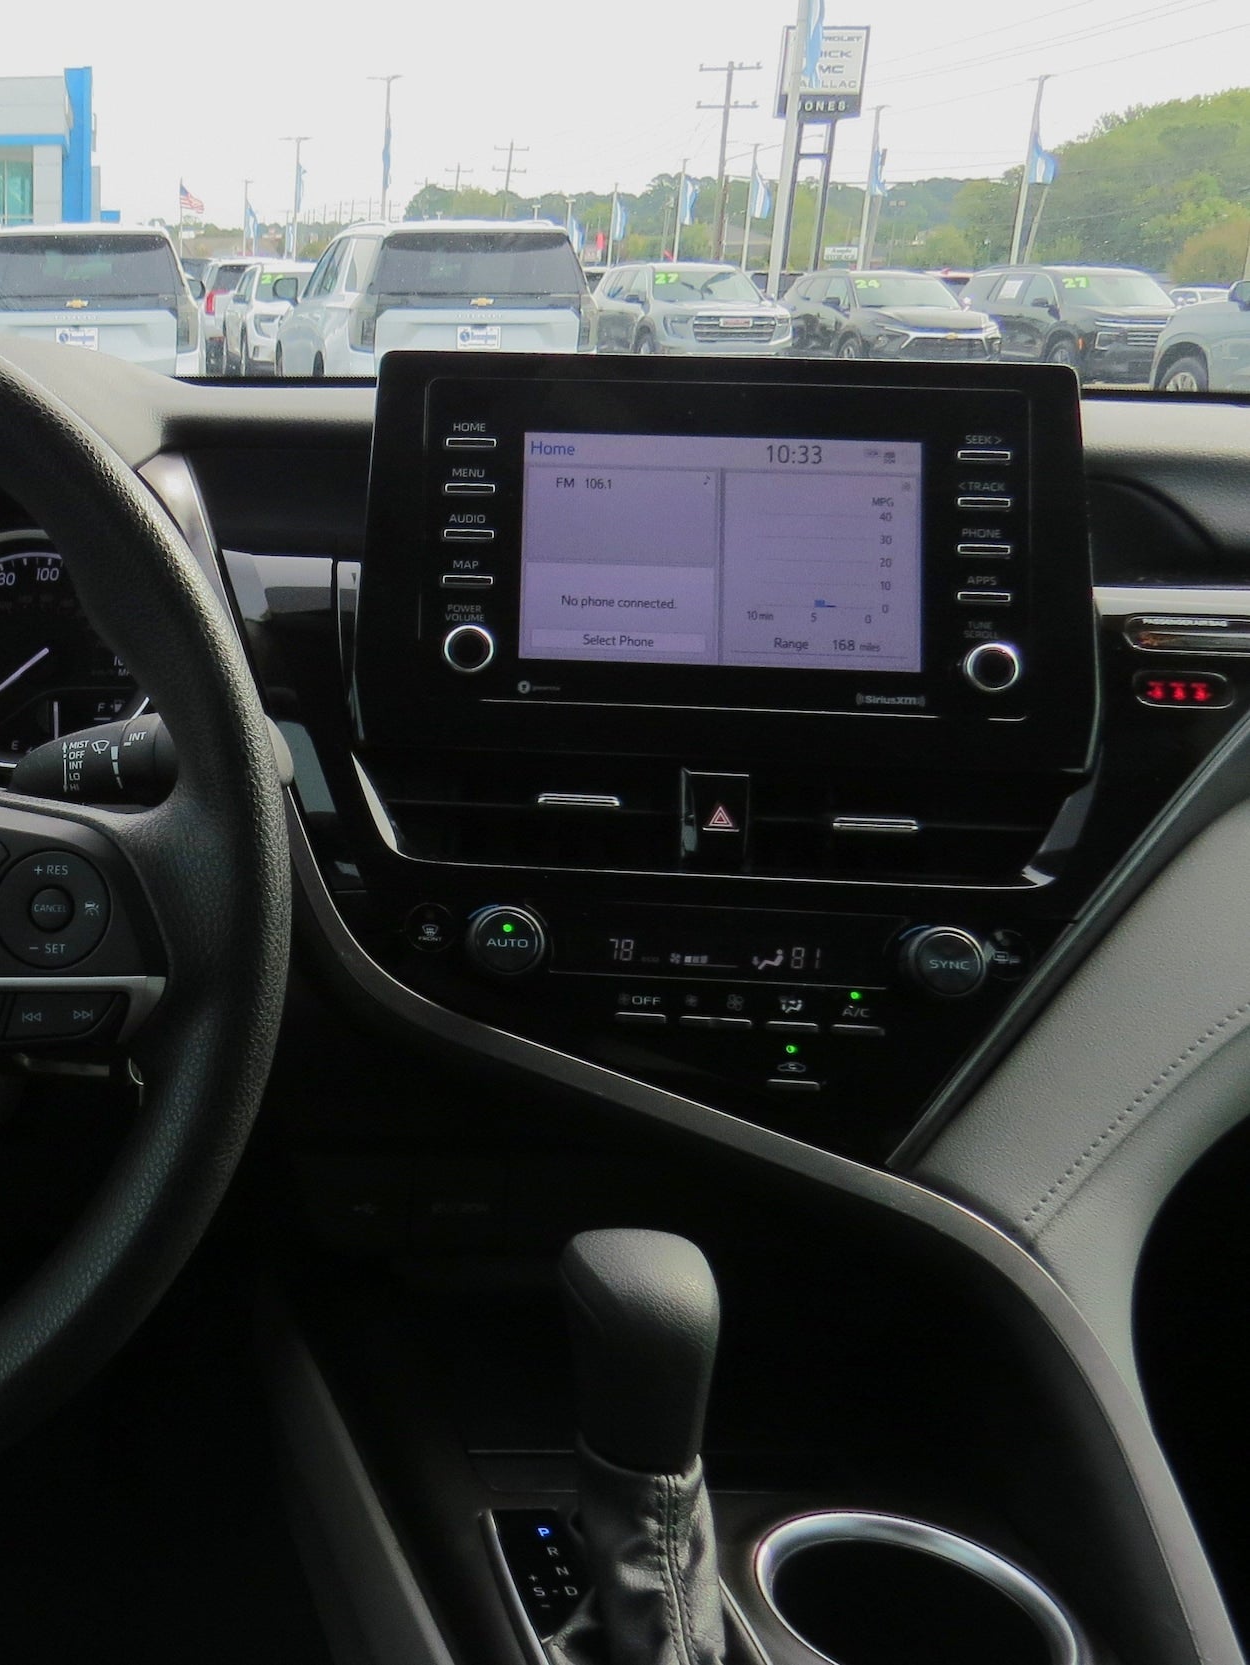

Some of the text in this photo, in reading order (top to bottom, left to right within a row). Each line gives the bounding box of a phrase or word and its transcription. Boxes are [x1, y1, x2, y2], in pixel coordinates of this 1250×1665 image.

[654, 273, 679, 285] 27
[854, 279, 880, 289] 24
[1061, 276, 1088, 289] 27
[452, 422, 486, 432] HOME
[965, 434, 993, 445] SEEK
[530, 441, 575, 456] Home
[766, 444, 823, 464] 10:33
[451, 468, 485, 478] MENU
[556, 477, 612, 490] FM 106.1
[968, 481, 1006, 492] TRACK
[871, 497, 894, 508] MPG
[449, 513, 486, 524] AUDIO
[879, 512, 892, 522] 40
[961, 528, 1002, 539] PHONE
[879, 535, 892, 545] 30
[452, 560, 479, 569] MAP
[879, 558, 892, 568] 20
[36, 567, 60, 582] 100
[880, 580, 892, 591] 10
[966, 575, 997, 586] APPS
[561, 595, 677, 610] No phone connected.
[447, 604, 482, 613] POWER
[882, 604, 889, 614] 0
[445, 612, 485, 622] VOLUME
[747, 610, 774, 621] 10 min
[810, 612, 818, 622] 5
[865, 614, 873, 624] 0
[968, 620, 993, 630] TUNE
[583, 633, 654, 648] Select Phone
[963, 630, 999, 640] SCROLL
[774, 637, 810, 651] Range
[833, 640, 856, 651] 168
[129, 731, 147, 741] INT
[68, 740, 90, 750] MIST
[68, 750, 86, 760] OFF
[69, 760, 84, 770] INT
[69, 772, 81, 782] LO
[46, 865, 69, 876] RES
[33, 904, 68, 914] CANCEL
[486, 937, 529, 949] AUTO
[45, 943, 66, 955] SET
[610, 938, 635, 962] 78
[791, 947, 821, 969] 81
[929, 959, 970, 970] SYNC
[631, 995, 662, 1006] OFF
[841, 1008, 871, 1018] A/C
[537, 1527, 550, 1537] P
[546, 1546, 559, 1556] R
[555, 1565, 570, 1576] N
[533, 1587, 546, 1597] S
[564, 1585, 578, 1597] D
